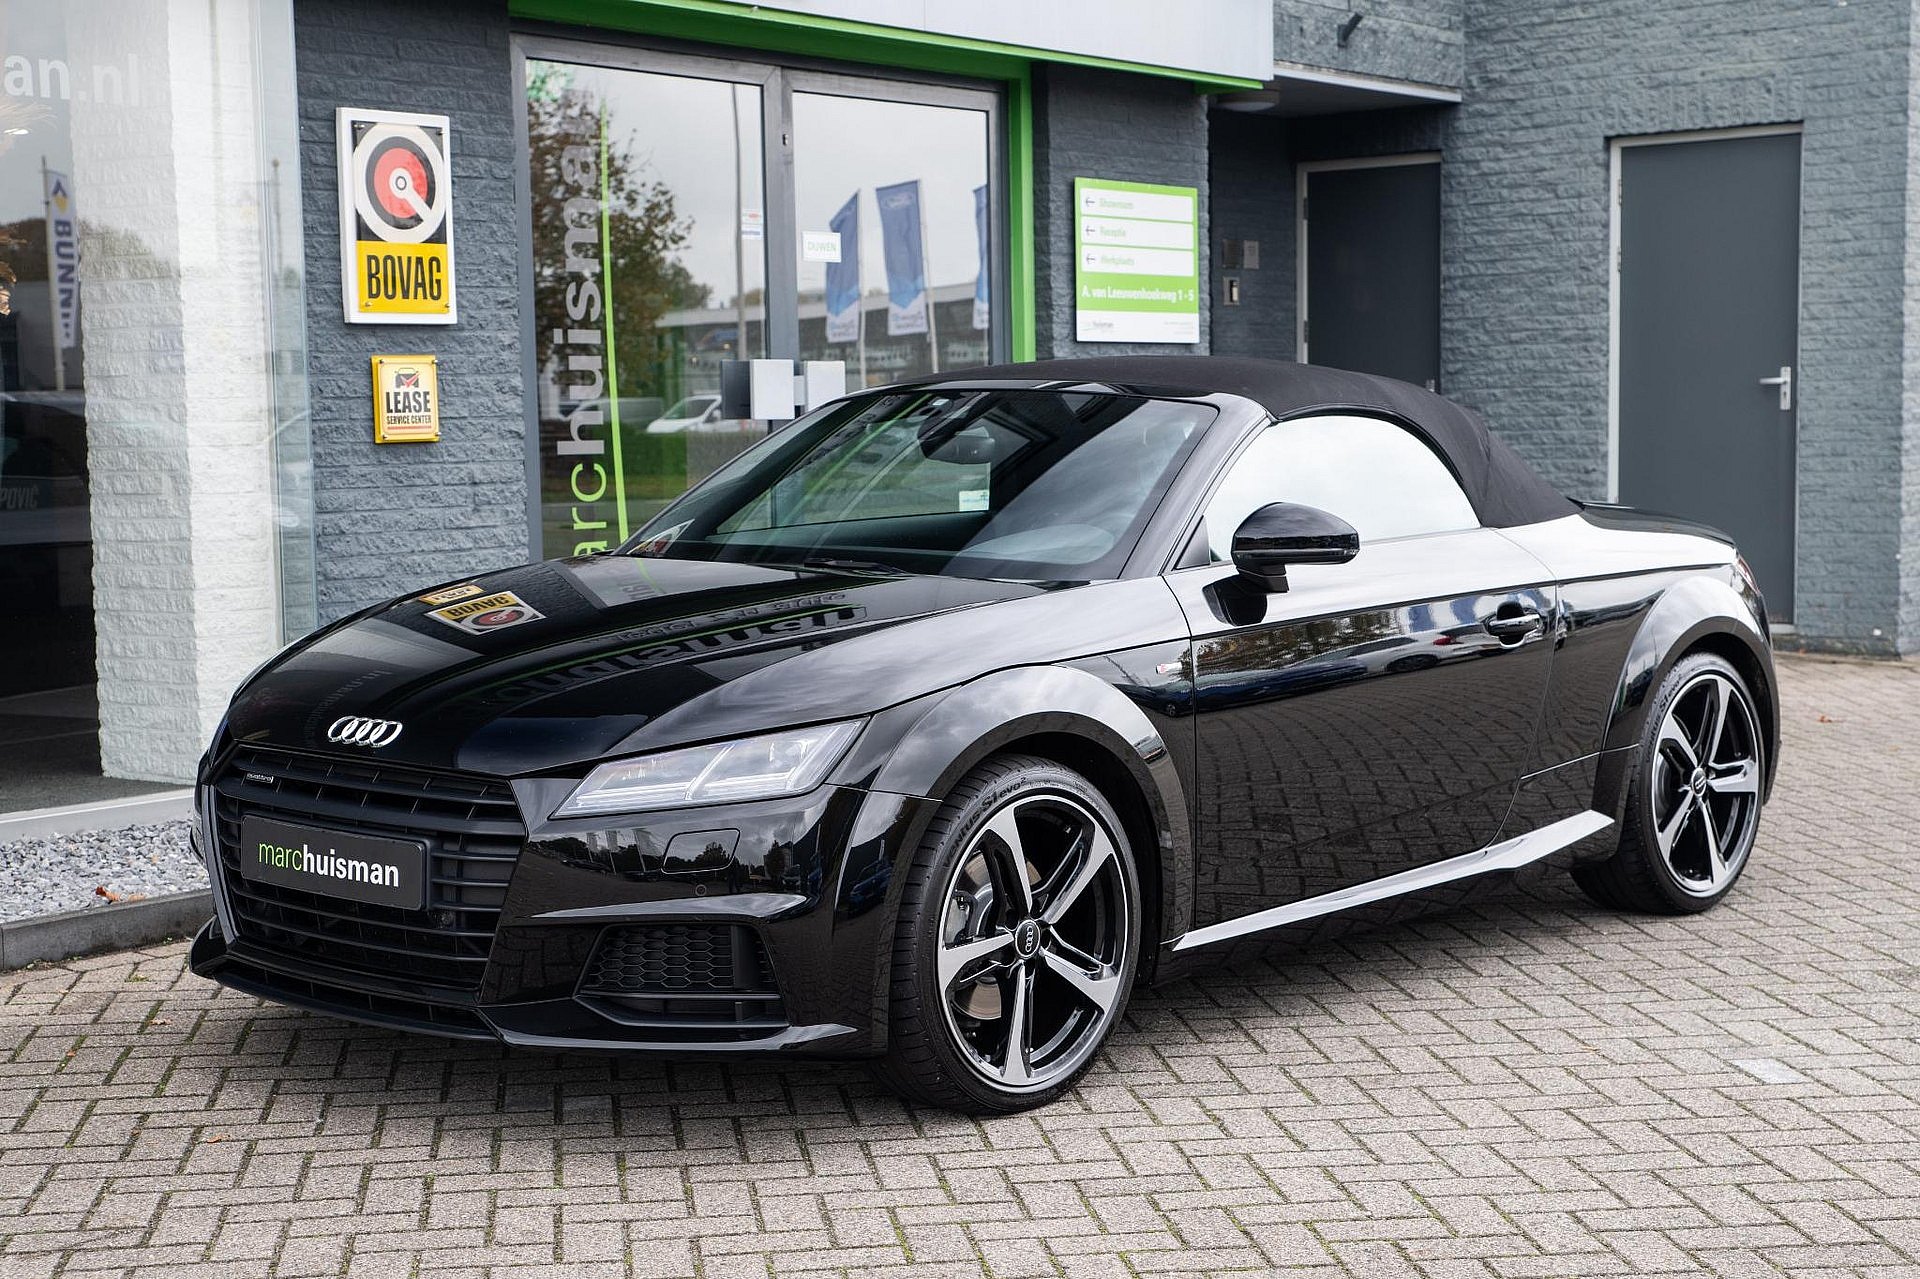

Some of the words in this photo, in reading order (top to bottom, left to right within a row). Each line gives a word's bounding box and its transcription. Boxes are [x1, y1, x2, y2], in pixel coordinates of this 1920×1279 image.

[366, 254, 442, 301] BOVAG
[385, 391, 431, 414] LEASE
[386, 415, 410, 425] SERVICE
[411, 414, 432, 425] CENTER
[258, 842, 399, 888] marchuisman
